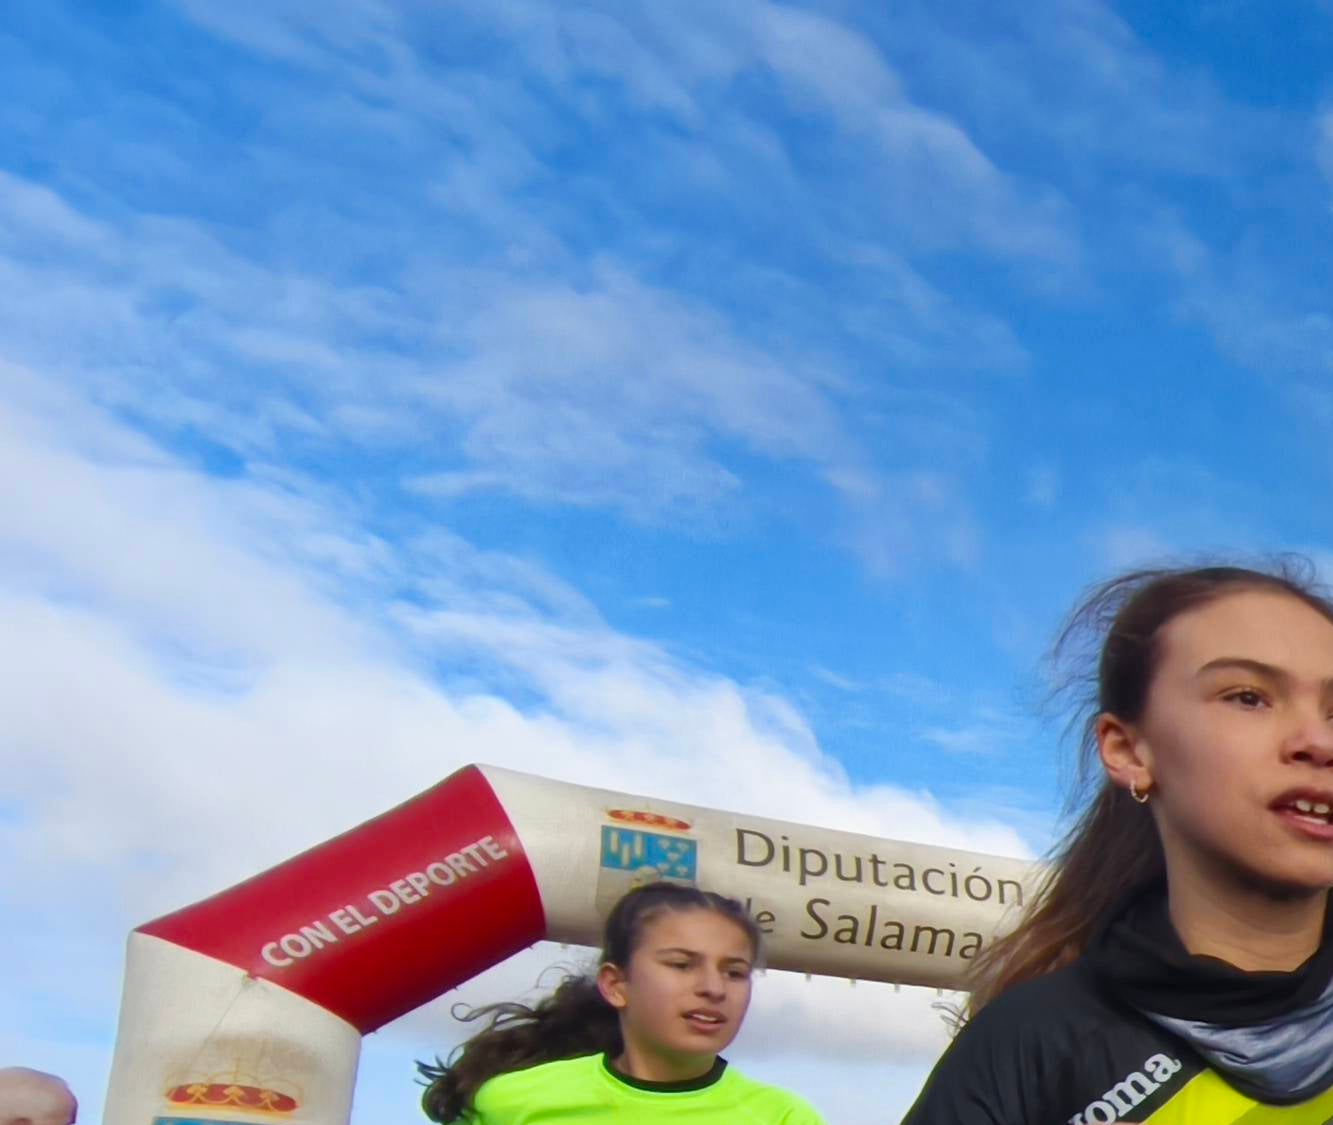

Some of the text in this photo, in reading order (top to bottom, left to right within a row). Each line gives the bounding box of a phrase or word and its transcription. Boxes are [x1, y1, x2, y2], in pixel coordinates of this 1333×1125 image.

[261, 835, 509, 967] CON EL DEPORTE
[735, 827, 1024, 906] Diputación
[800, 897, 984, 960] Salama
